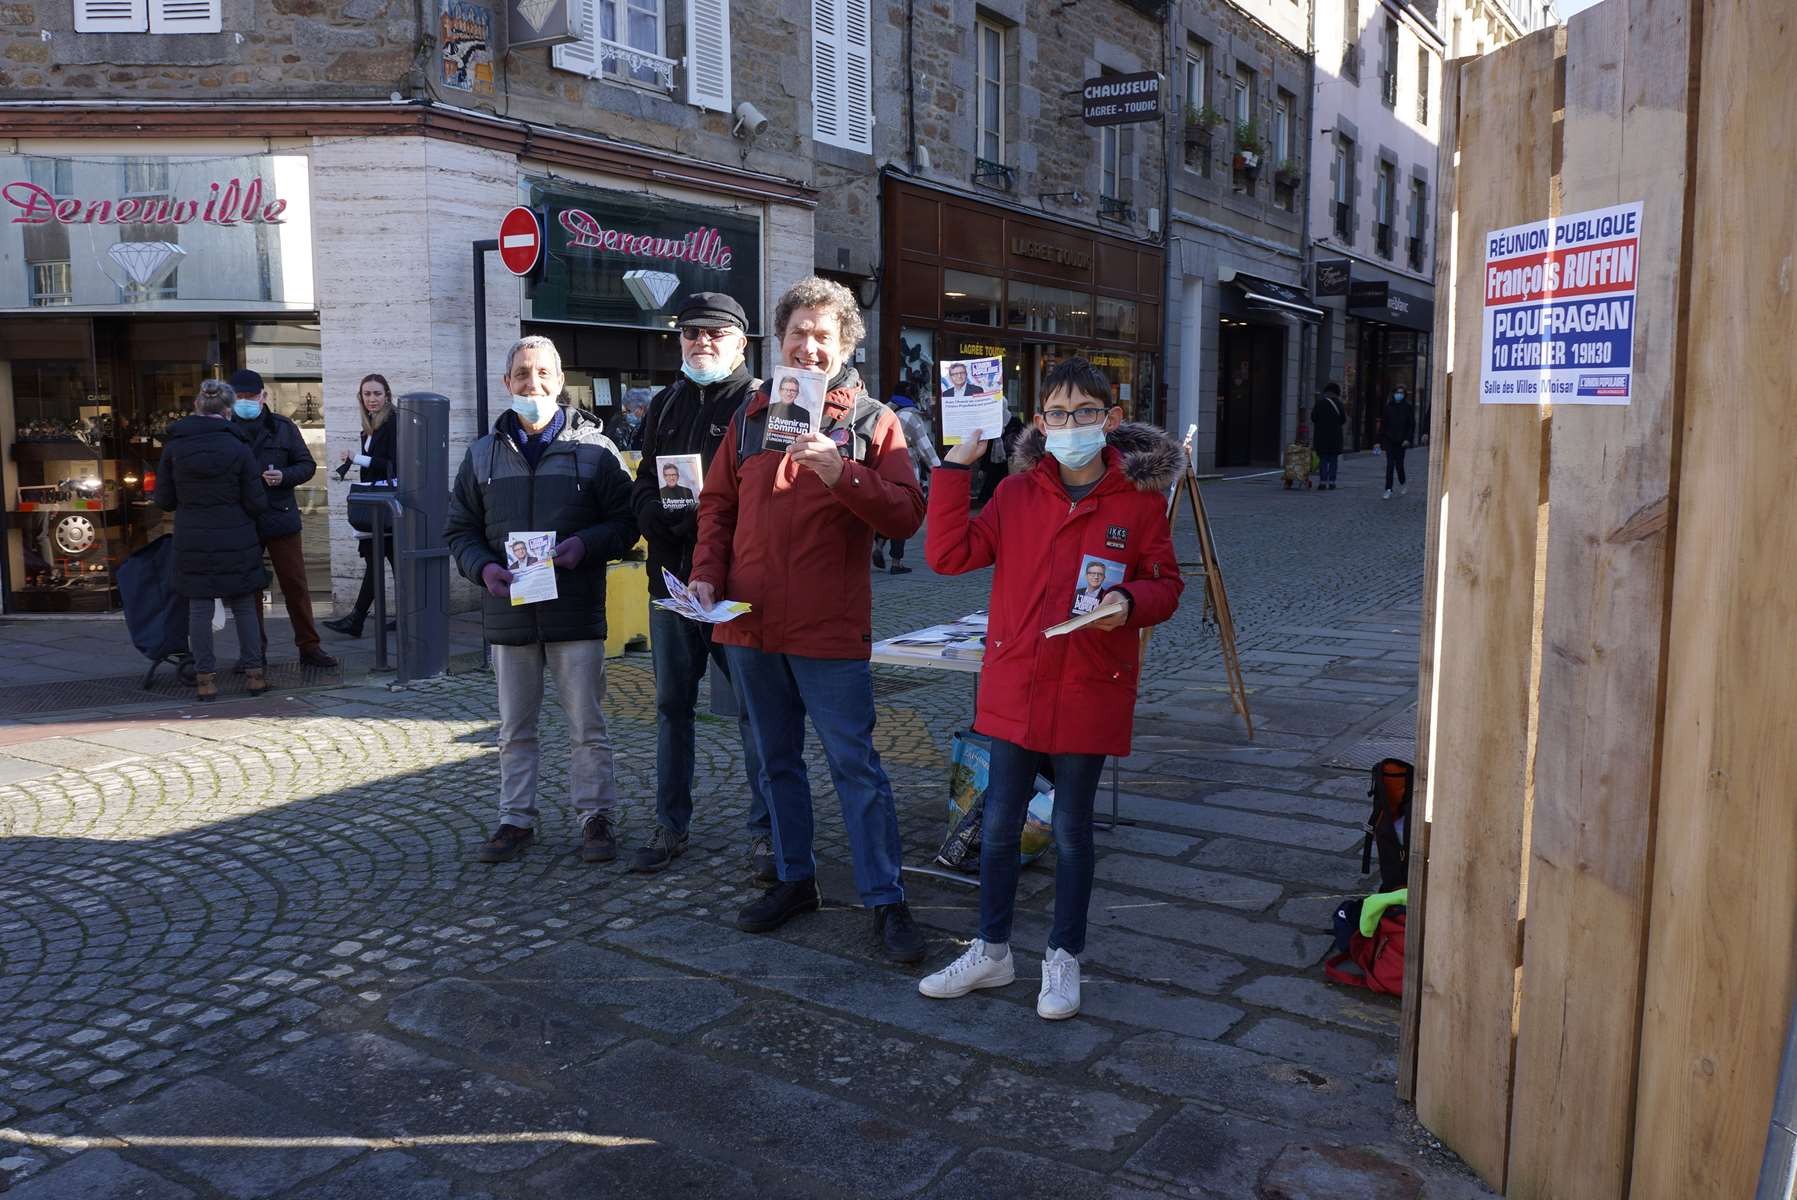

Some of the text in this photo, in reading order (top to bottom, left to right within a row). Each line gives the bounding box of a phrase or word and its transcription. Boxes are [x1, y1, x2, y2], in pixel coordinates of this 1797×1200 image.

[1084, 80, 1158, 98] CHAUSSEUR
[1085, 104, 1117, 118] LAGREE
[1124, 100, 1157, 113] TOUDIC
[1490, 212, 1636, 258] RÉUNION PUBLIQUE
[1487, 245, 1634, 300] François RUFFIN
[1495, 301, 1629, 338] PLOUFRAGAN
[1493, 338, 1612, 368] 10 FÉVRIER 19H30
[1484, 380, 1501, 394] Salle
[1502, 381, 1514, 394] des
[1516, 379, 1537, 394] Villes
[768, 423, 808, 434] commun
[769, 416, 798, 427] L'Avenir
[1109, 528, 1126, 537] IKKS
